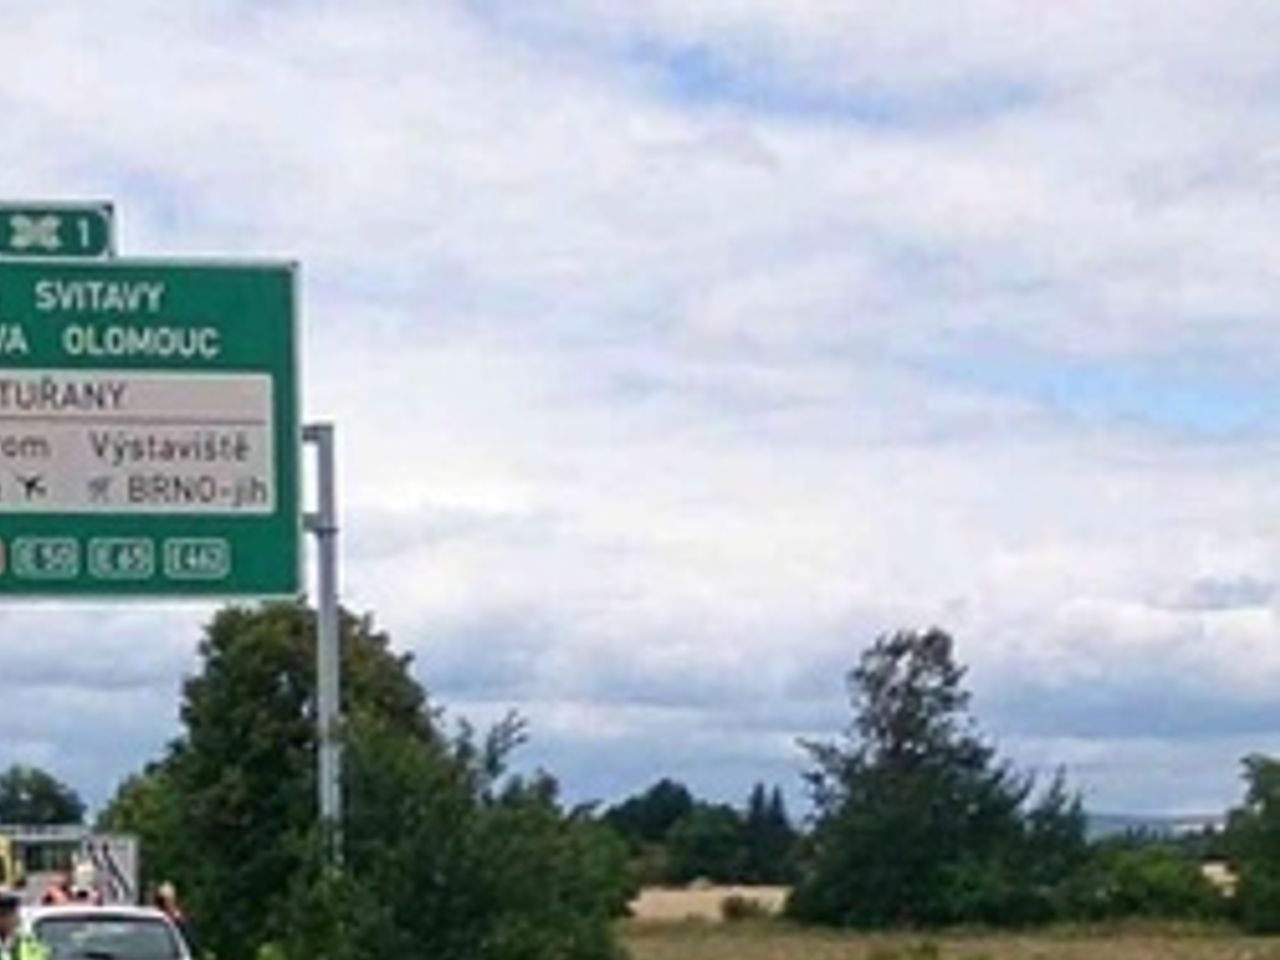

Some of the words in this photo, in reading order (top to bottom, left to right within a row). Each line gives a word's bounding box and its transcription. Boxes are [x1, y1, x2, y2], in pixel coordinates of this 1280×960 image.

[77, 218, 90, 248] 1
[34, 280, 166, 313] SVITAVY
[61, 325, 221, 358] OLOMOUC
